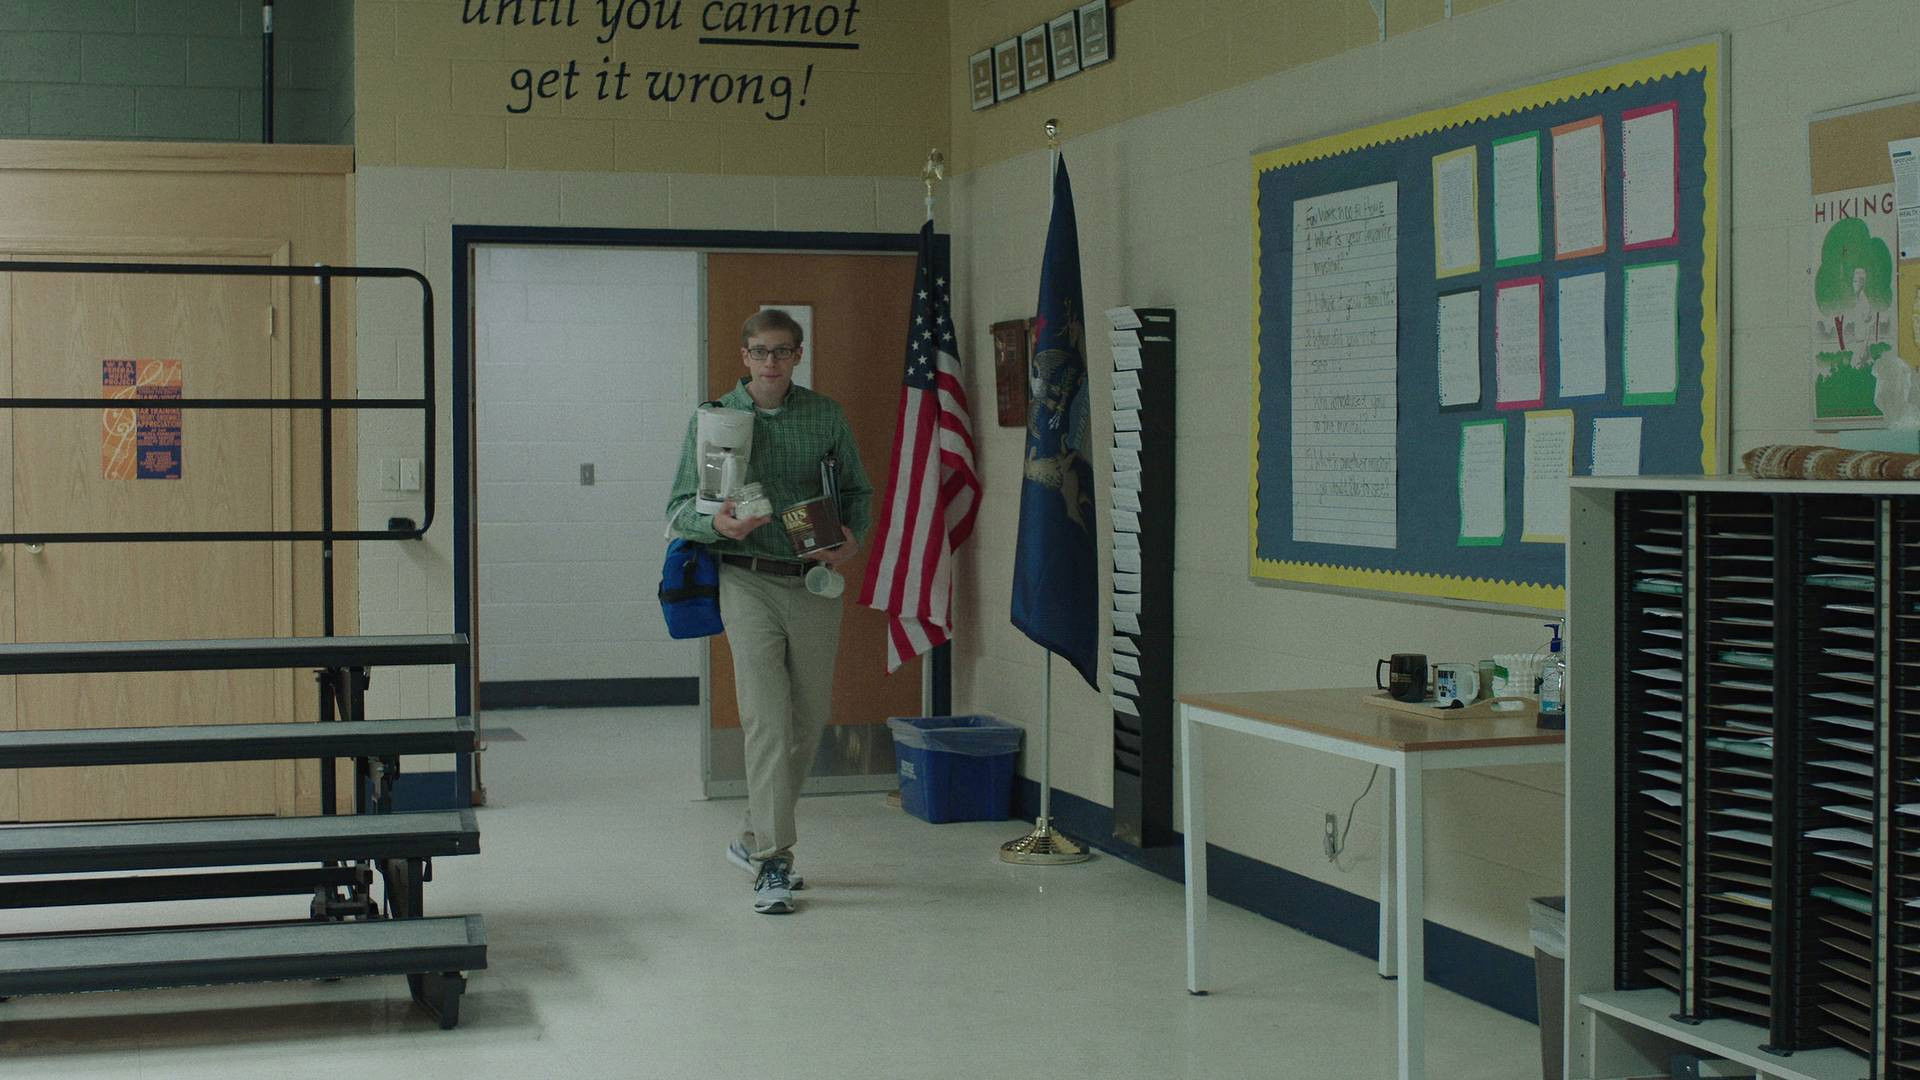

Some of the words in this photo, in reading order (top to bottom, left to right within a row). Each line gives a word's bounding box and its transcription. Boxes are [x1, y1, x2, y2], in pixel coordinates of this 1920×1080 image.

[597, 0, 682, 44] you
[702, 0, 861, 37] cannot
[506, 60, 580, 114] get
[595, 56, 631, 101] it
[645, 64, 814, 121] wrong!
[1815, 192, 1894, 224] HIKING
